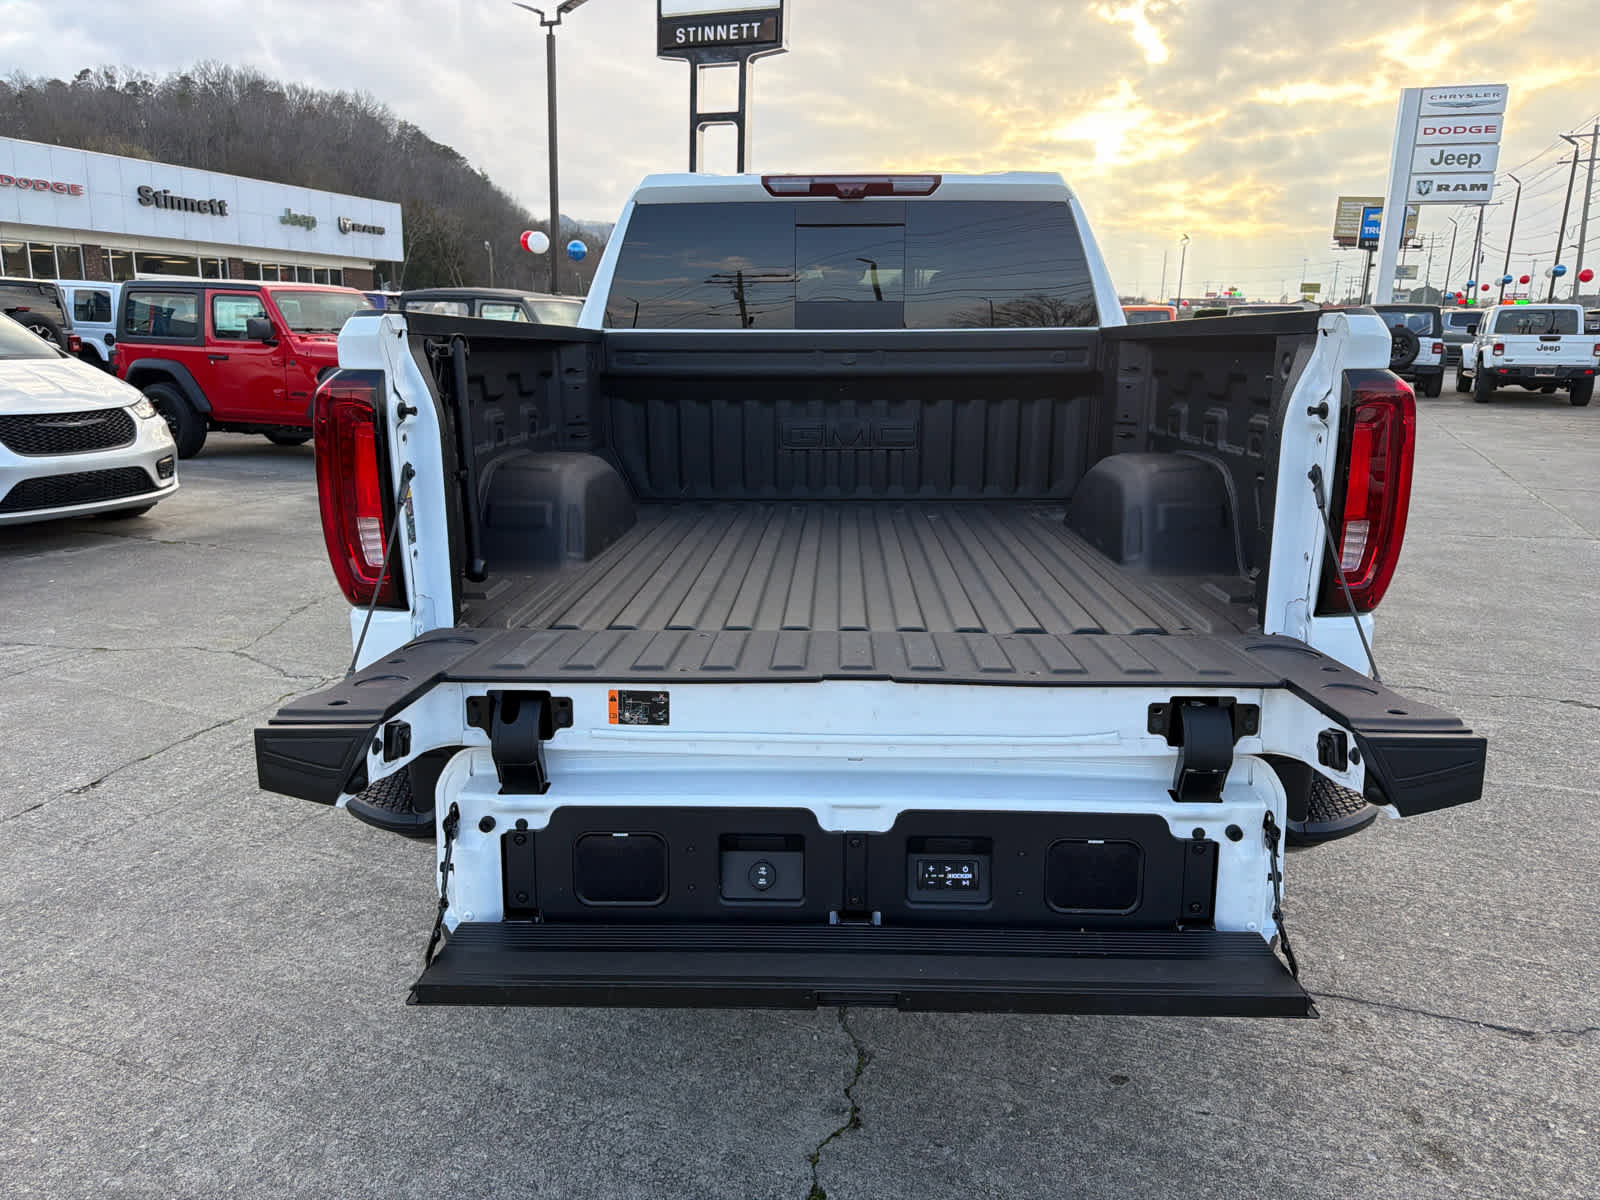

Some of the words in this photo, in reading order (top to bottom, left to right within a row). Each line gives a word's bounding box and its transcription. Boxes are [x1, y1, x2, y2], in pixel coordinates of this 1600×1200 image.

[675, 22, 761, 44] STINNETT
[1430, 92, 1501, 100] CHRYSLER
[1423, 125, 1497, 136] DODGE
[1430, 149, 1482, 168] Jeep
[0, 174, 84, 196] DODGE
[1436, 183, 1489, 192] RAM
[137, 185, 228, 216] Stinnett
[1536, 343, 1561, 352] Jeep
[780, 421, 917, 450] GMC
